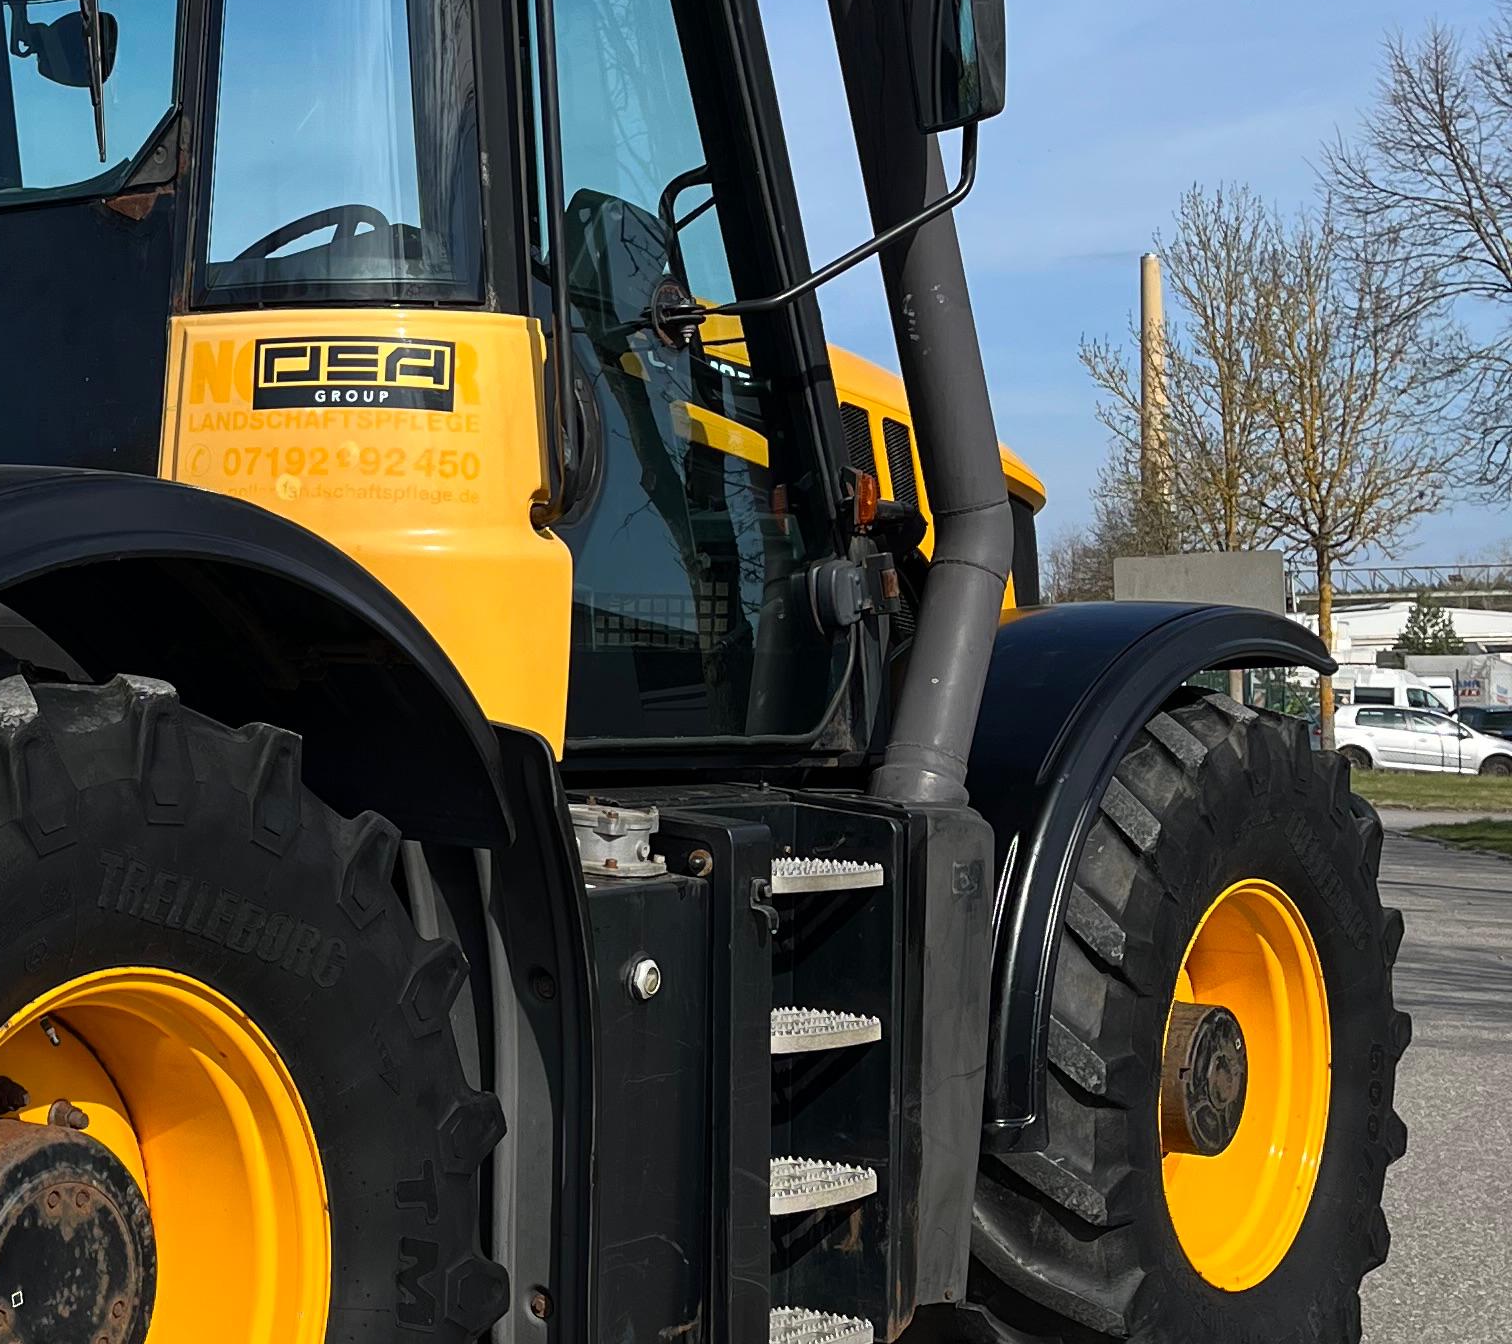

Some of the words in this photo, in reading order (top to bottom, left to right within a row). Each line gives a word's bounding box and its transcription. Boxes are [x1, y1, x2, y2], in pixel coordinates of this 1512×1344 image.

[314, 389, 390, 404] GROUP
[188, 410, 481, 434] LANDSCHAFTSPFLEGE
[223, 447, 329, 477] 07192
[95, 845, 349, 990] TRELLEBORG
